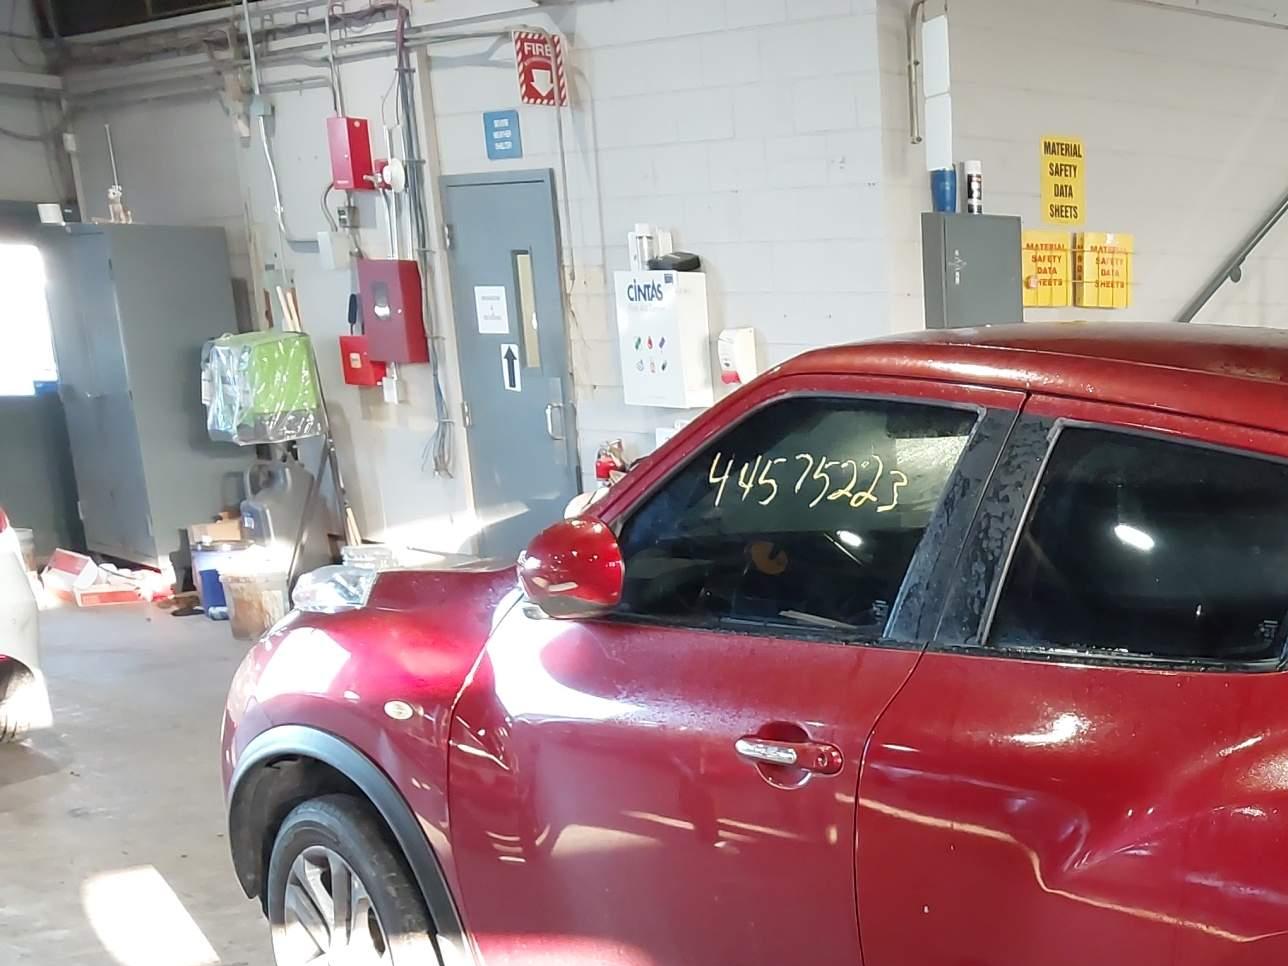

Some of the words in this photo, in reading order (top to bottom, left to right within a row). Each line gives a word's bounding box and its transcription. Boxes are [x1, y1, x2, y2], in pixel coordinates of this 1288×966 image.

[524, 42, 552, 57] FIRE
[1043, 140, 1083, 158] MATERIAL
[1048, 163, 1078, 178] SAFETY
[1053, 184, 1074, 199] DATA
[1049, 204, 1079, 219] SHEETS
[1031, 255, 1062, 263] SAFETY
[1037, 267, 1058, 275] DATA
[709, 452, 908, 512] 44575223
